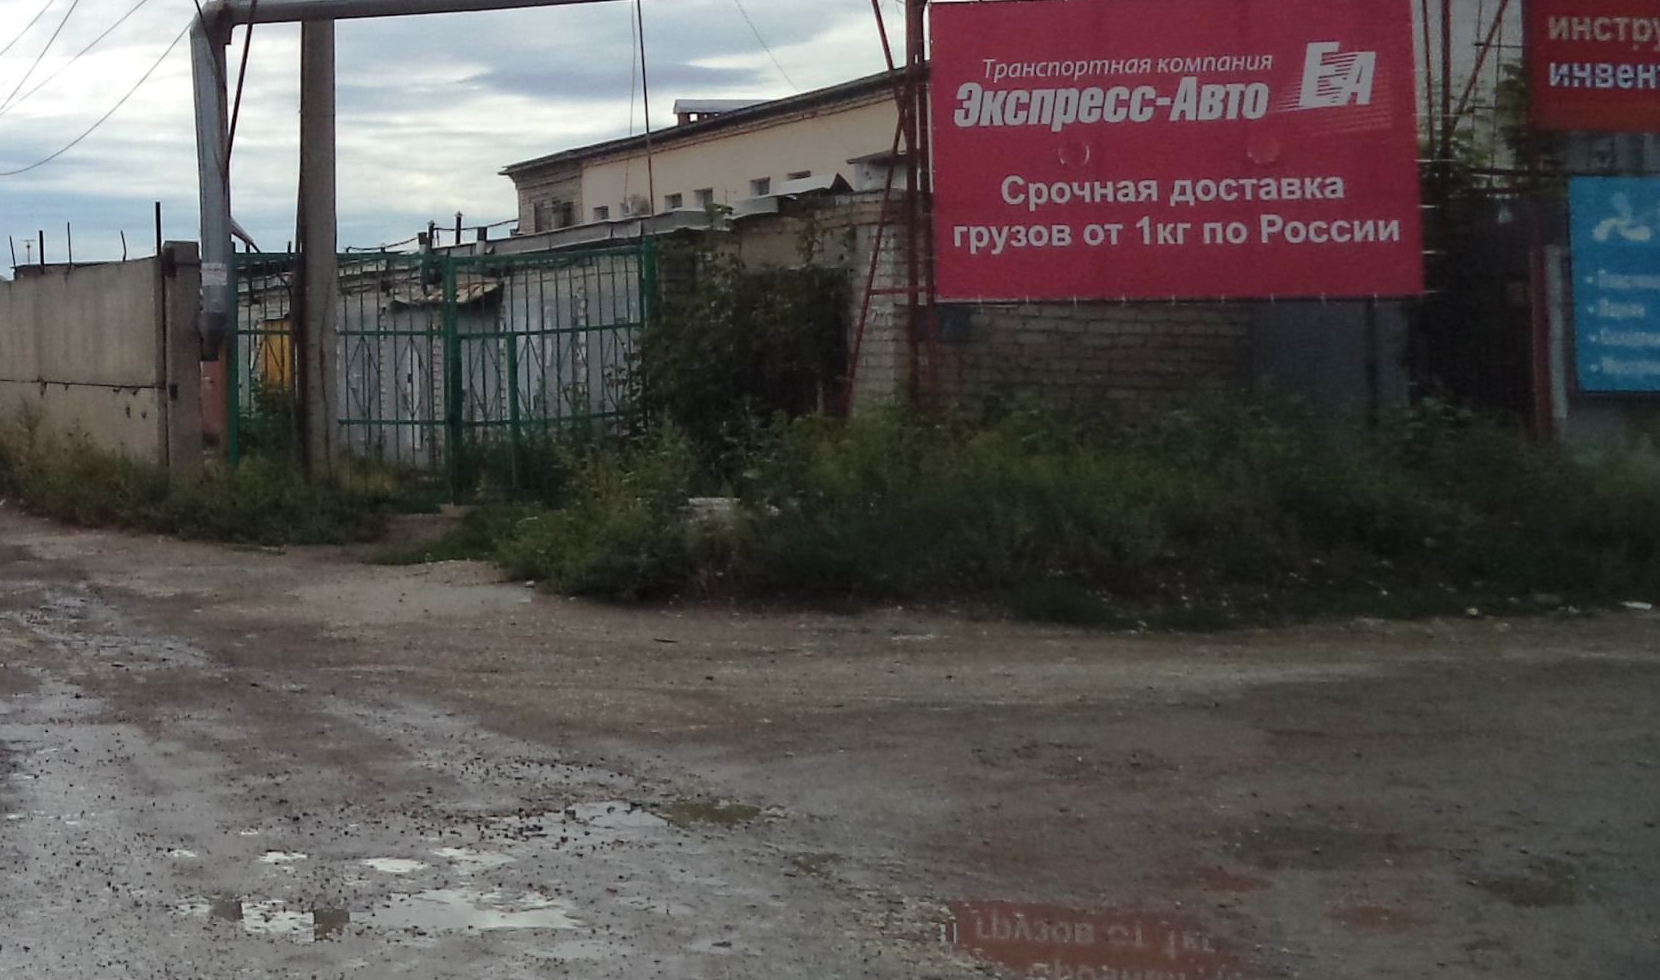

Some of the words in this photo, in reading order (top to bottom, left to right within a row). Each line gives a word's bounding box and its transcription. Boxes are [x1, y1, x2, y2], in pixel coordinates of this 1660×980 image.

[983, 57, 1152, 83] Транспортная
[1157, 54, 1273, 74] компания
[1549, 62, 1660, 89] инвен
[954, 76, 1269, 132] Экспресс-Авто
[1001, 175, 1158, 211] Срочная
[1169, 176, 1345, 207] доставка
[953, 223, 1072, 255] грузов
[1083, 223, 1123, 246] от
[1139, 216, 1191, 246] 1кг
[1203, 222, 1248, 245] по
[1260, 214, 1400, 244] России
